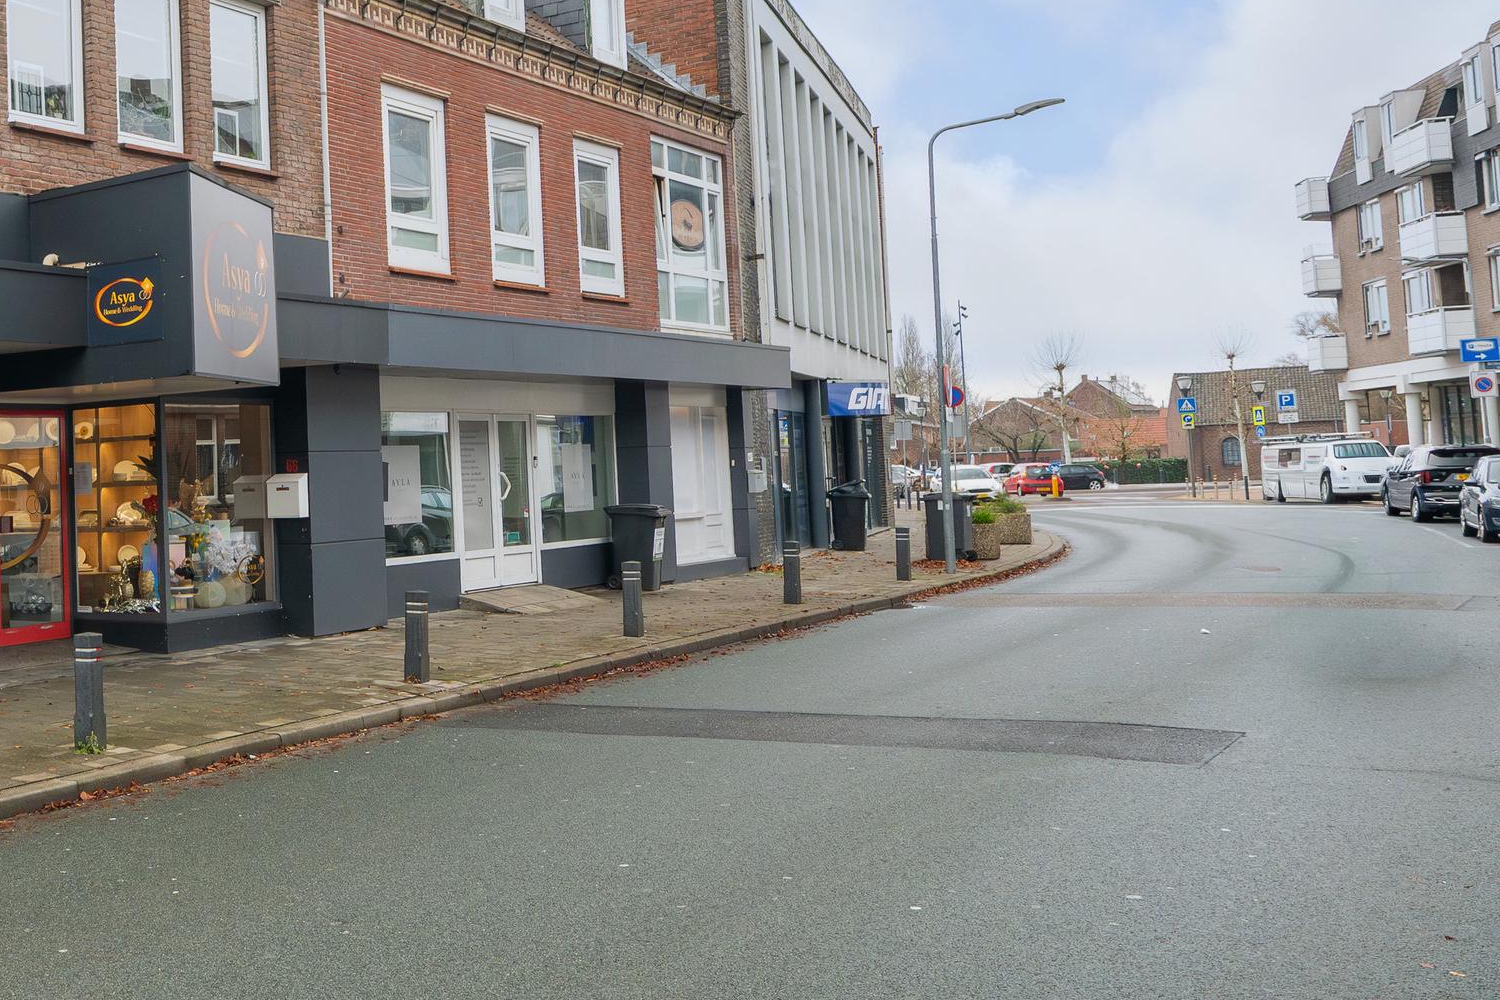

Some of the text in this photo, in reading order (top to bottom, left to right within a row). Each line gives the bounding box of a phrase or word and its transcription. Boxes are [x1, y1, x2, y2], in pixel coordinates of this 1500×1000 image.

[222, 252, 251, 301] Asya
[110, 291, 135, 306] Asya
[103, 308, 117, 316] Home
[1282, 395, 1291, 405] P
[391, 478, 411, 487] AYLA
